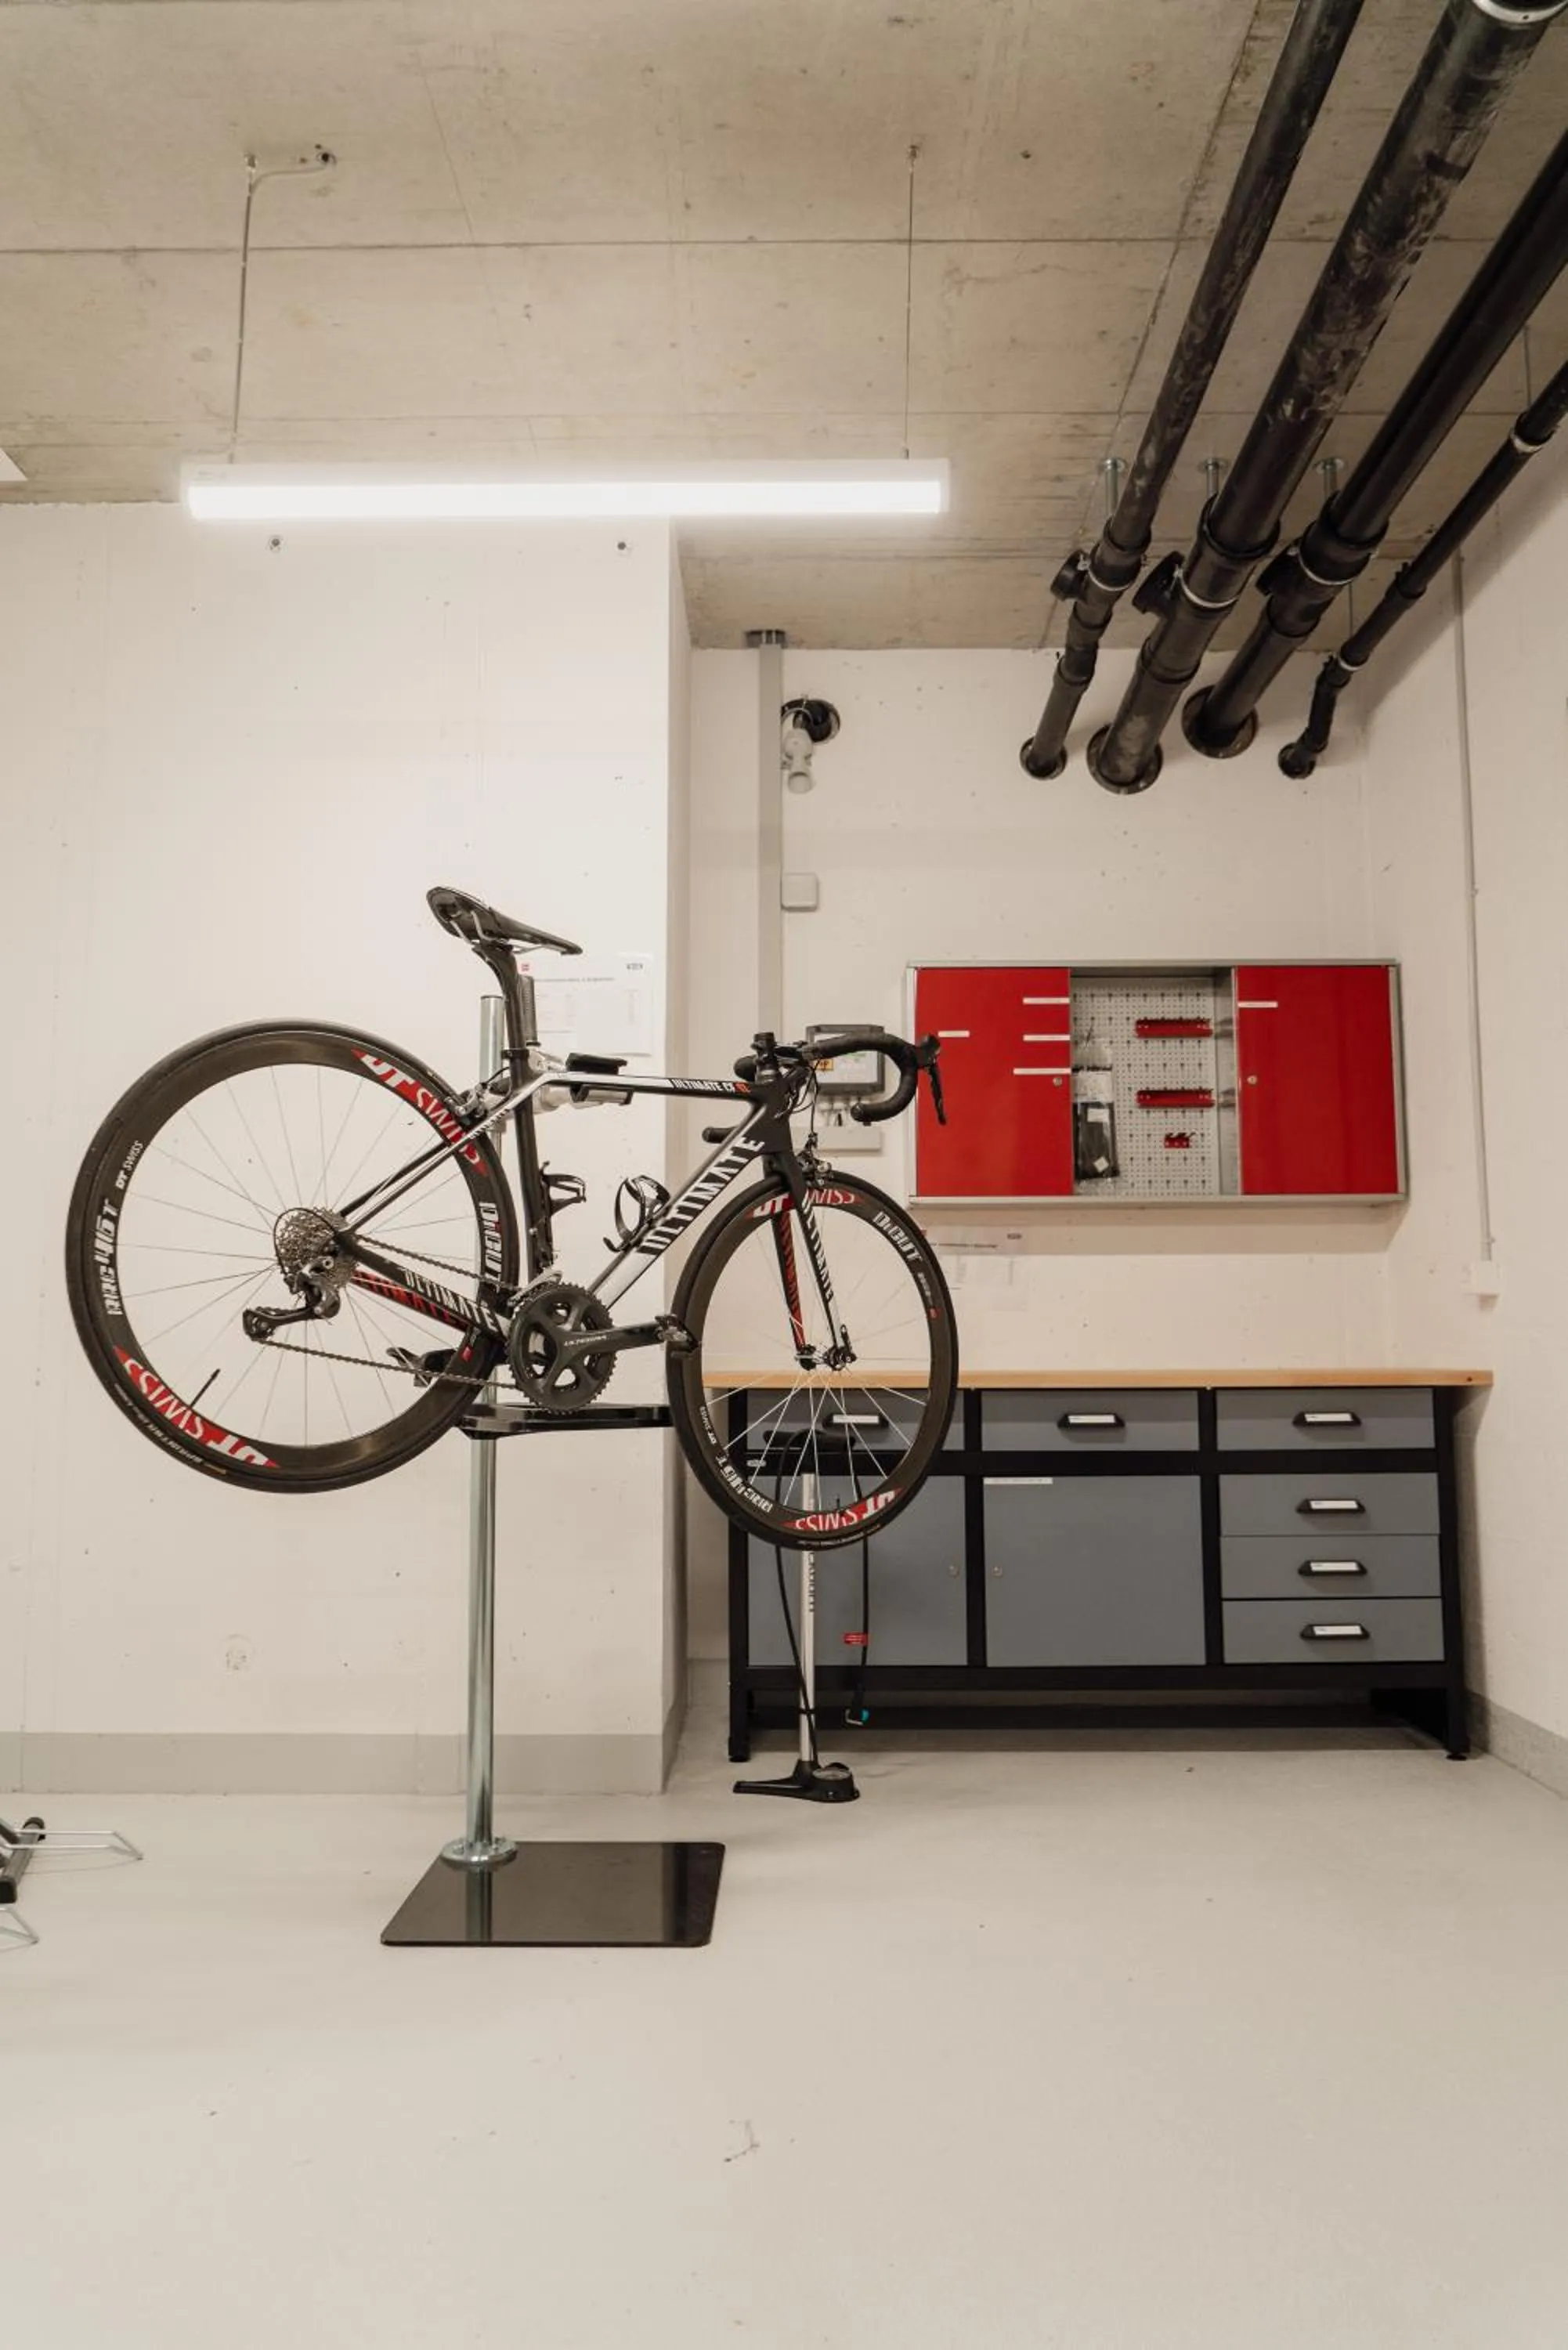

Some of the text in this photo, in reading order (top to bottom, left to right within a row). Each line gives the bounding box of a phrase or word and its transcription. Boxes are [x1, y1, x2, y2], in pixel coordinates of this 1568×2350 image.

[360, 1054, 417, 1088] DT
[115, 1139, 144, 1190] DT SWISS
[638, 1137, 765, 1251] ULTIMATE
[753, 1188, 855, 1217] DT WISS
[123, 1358, 204, 1440] SWISS
[207, 1434, 270, 1466] DT
[795, 1490, 896, 1531] DT SWISS
